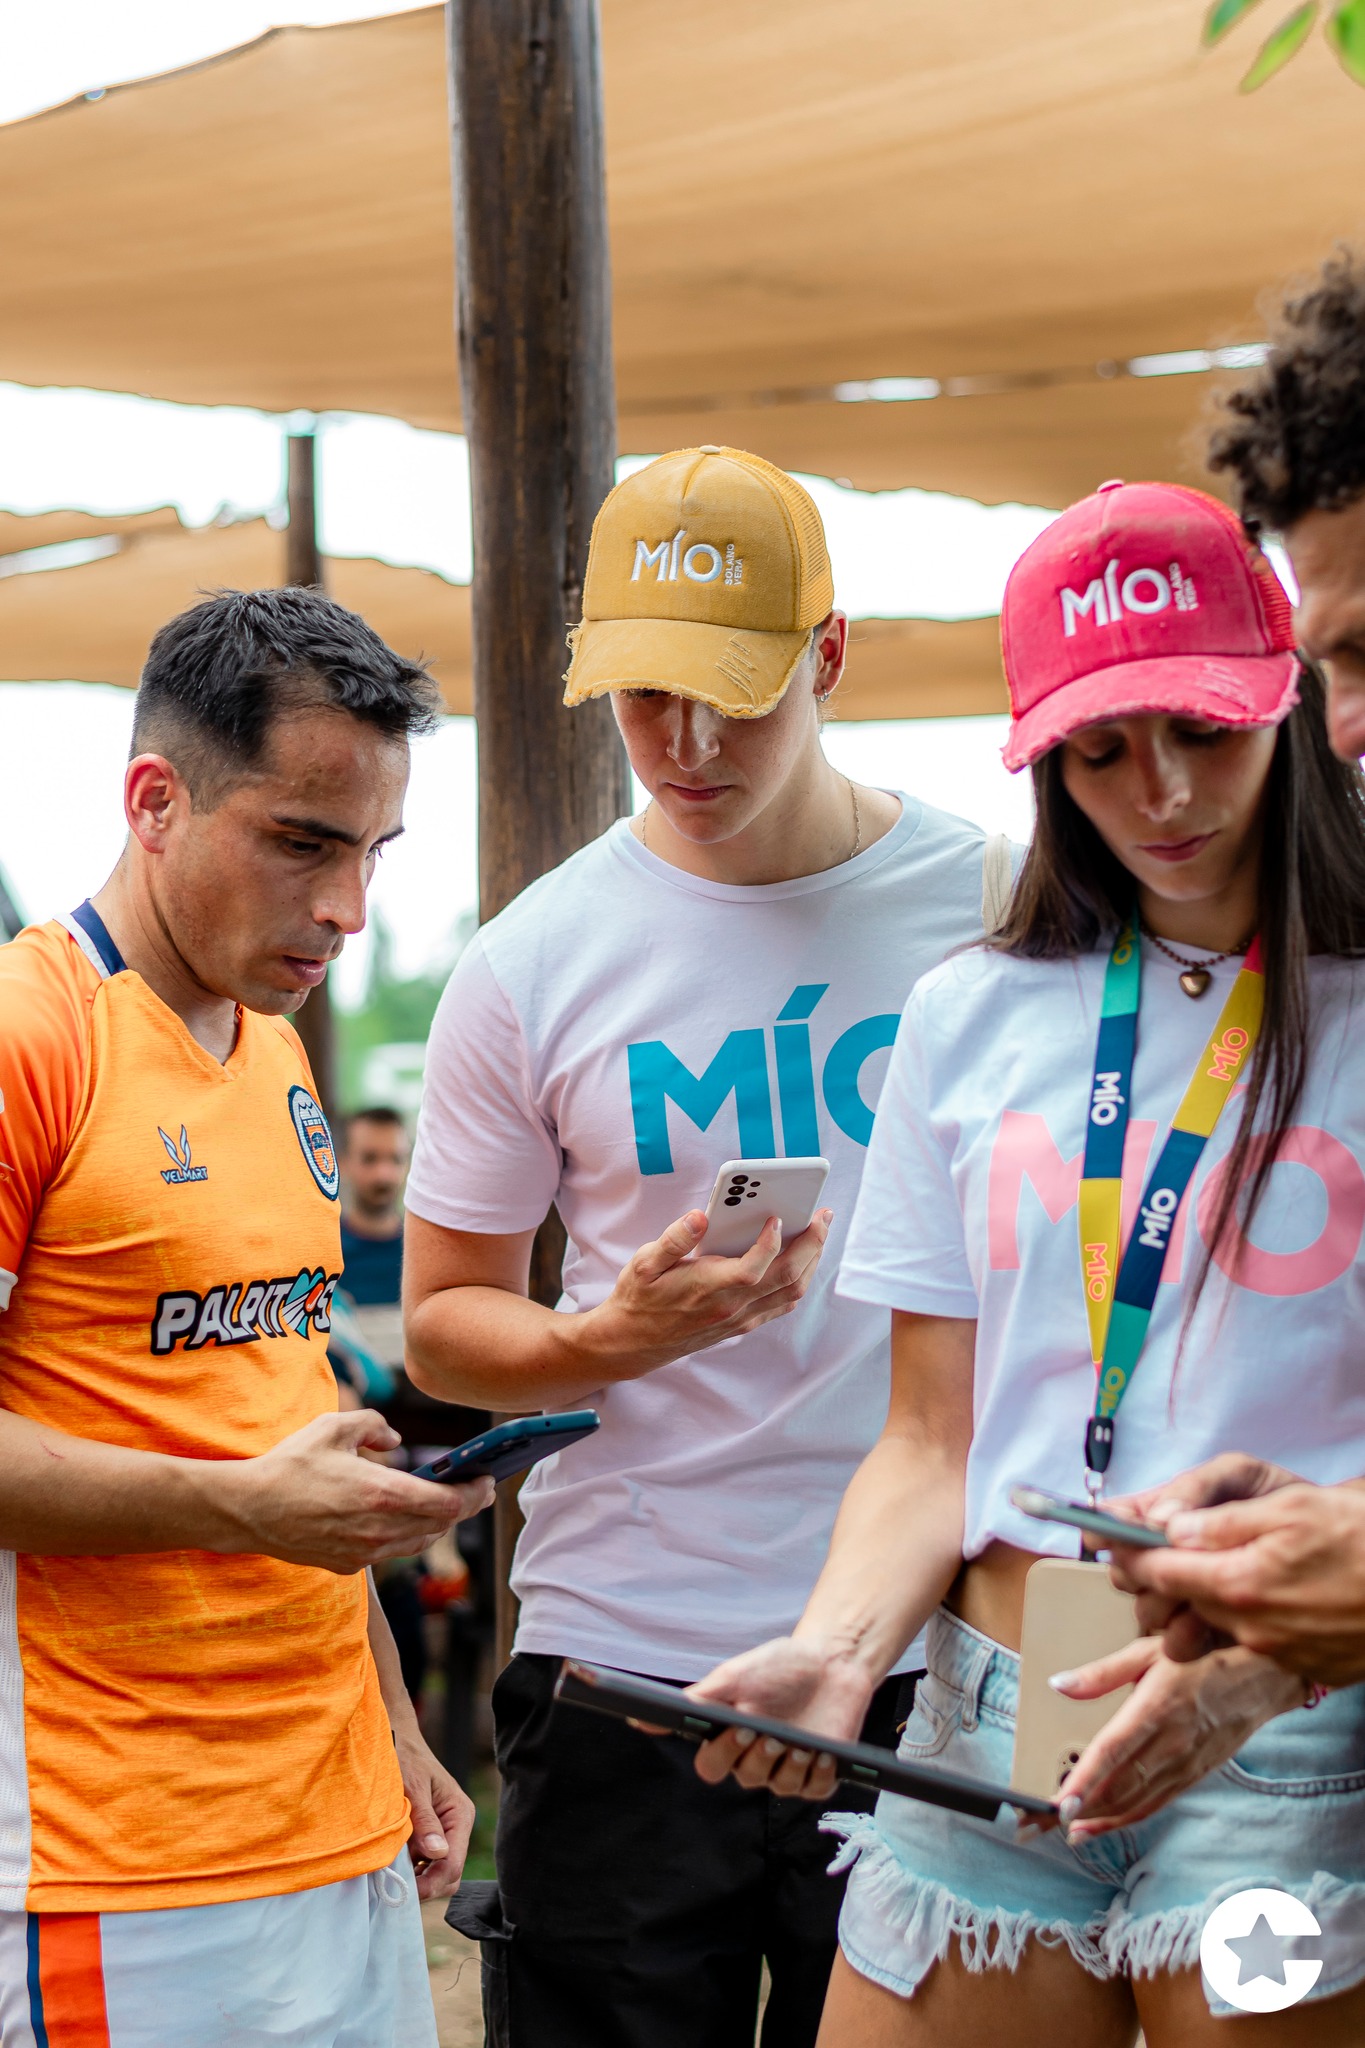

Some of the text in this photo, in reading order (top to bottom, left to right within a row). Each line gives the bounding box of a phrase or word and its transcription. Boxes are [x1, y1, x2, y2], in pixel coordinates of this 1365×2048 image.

[630, 529, 723, 583] MÍO
[724, 543, 735, 586] SOLANO
[733, 558, 743, 586] VERA
[1060, 558, 1171, 638] MÍO
[1207, 1027, 1249, 1081] MÍO
[1090, 1071, 1125, 1126] MÍO
[160, 1166, 208, 1185] VELMART
[1139, 1187, 1178, 1250] MÍO
[1084, 1242, 1112, 1303] MÍO
